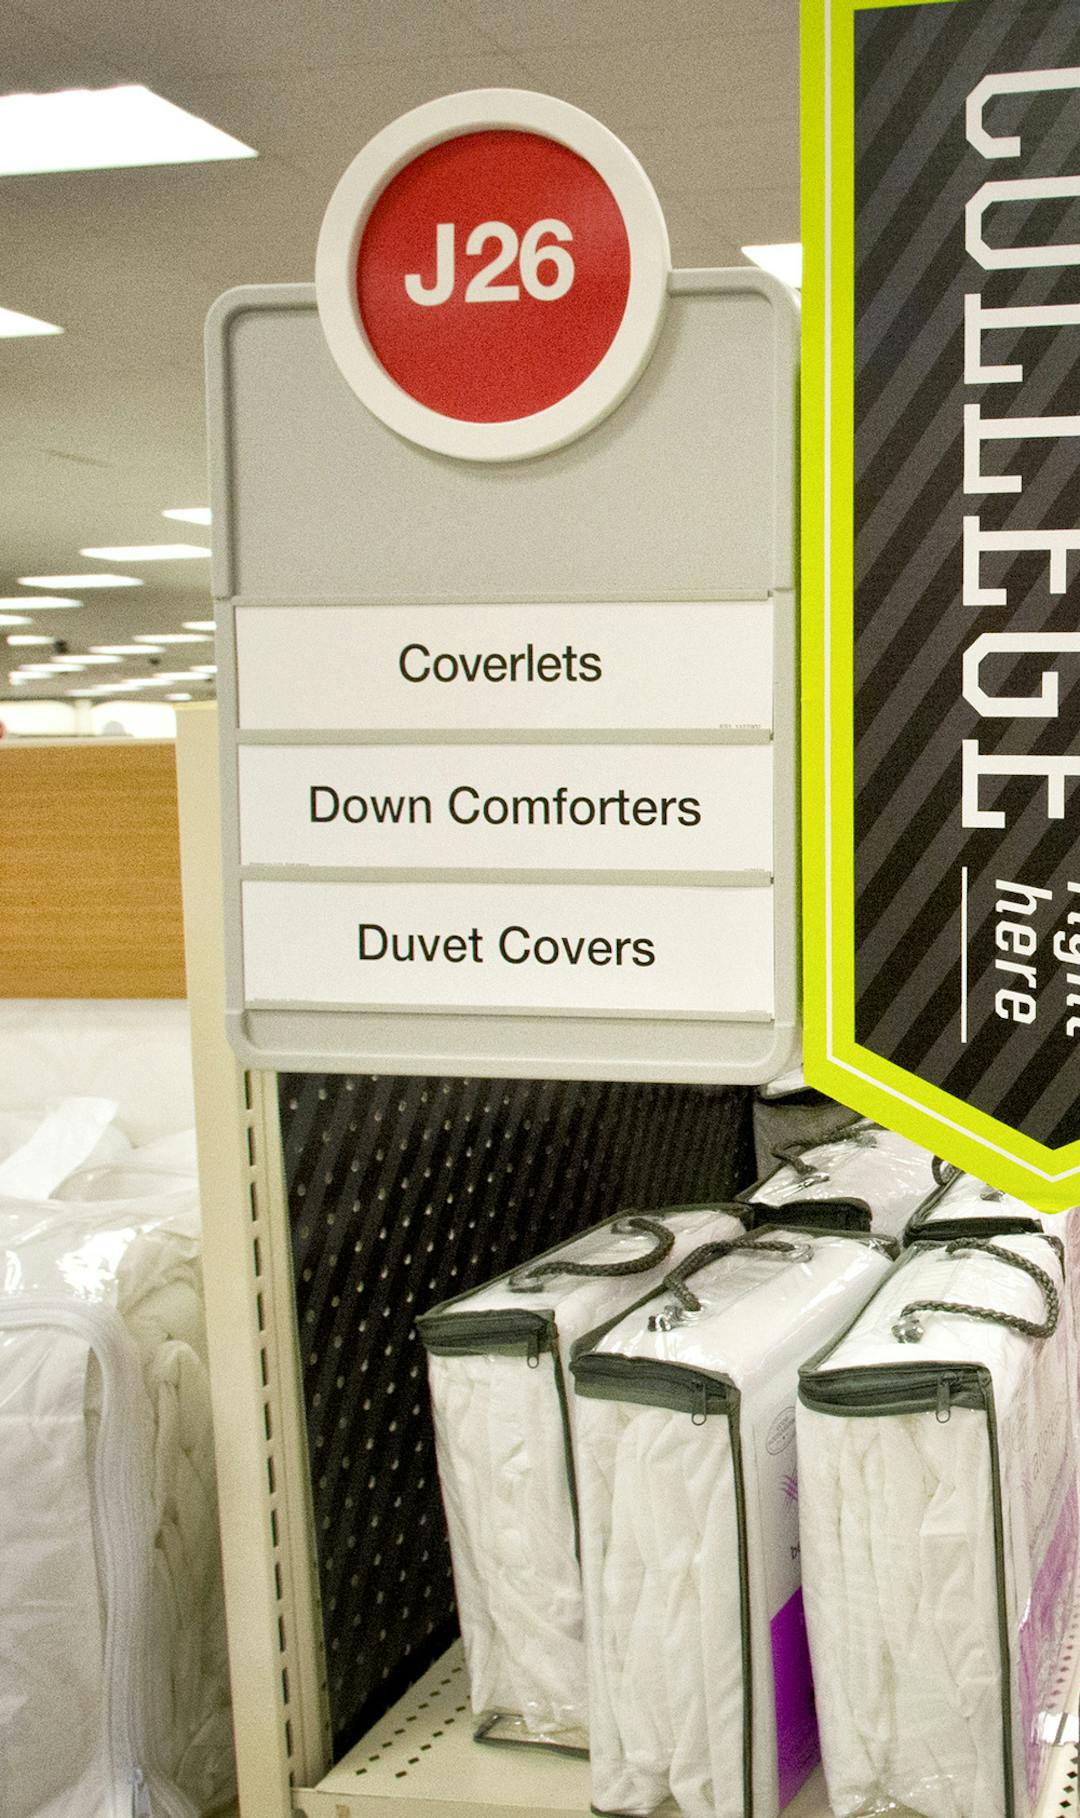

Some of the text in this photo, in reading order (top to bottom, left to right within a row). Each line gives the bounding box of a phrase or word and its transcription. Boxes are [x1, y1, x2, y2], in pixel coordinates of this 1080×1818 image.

[404, 218, 575, 307] J26
[400, 643, 602, 683] Coverlets
[310, 785, 701, 827] Down Comforters
[358, 923, 656, 967] Duvet Covers
[995, 879, 1053, 1025] here
